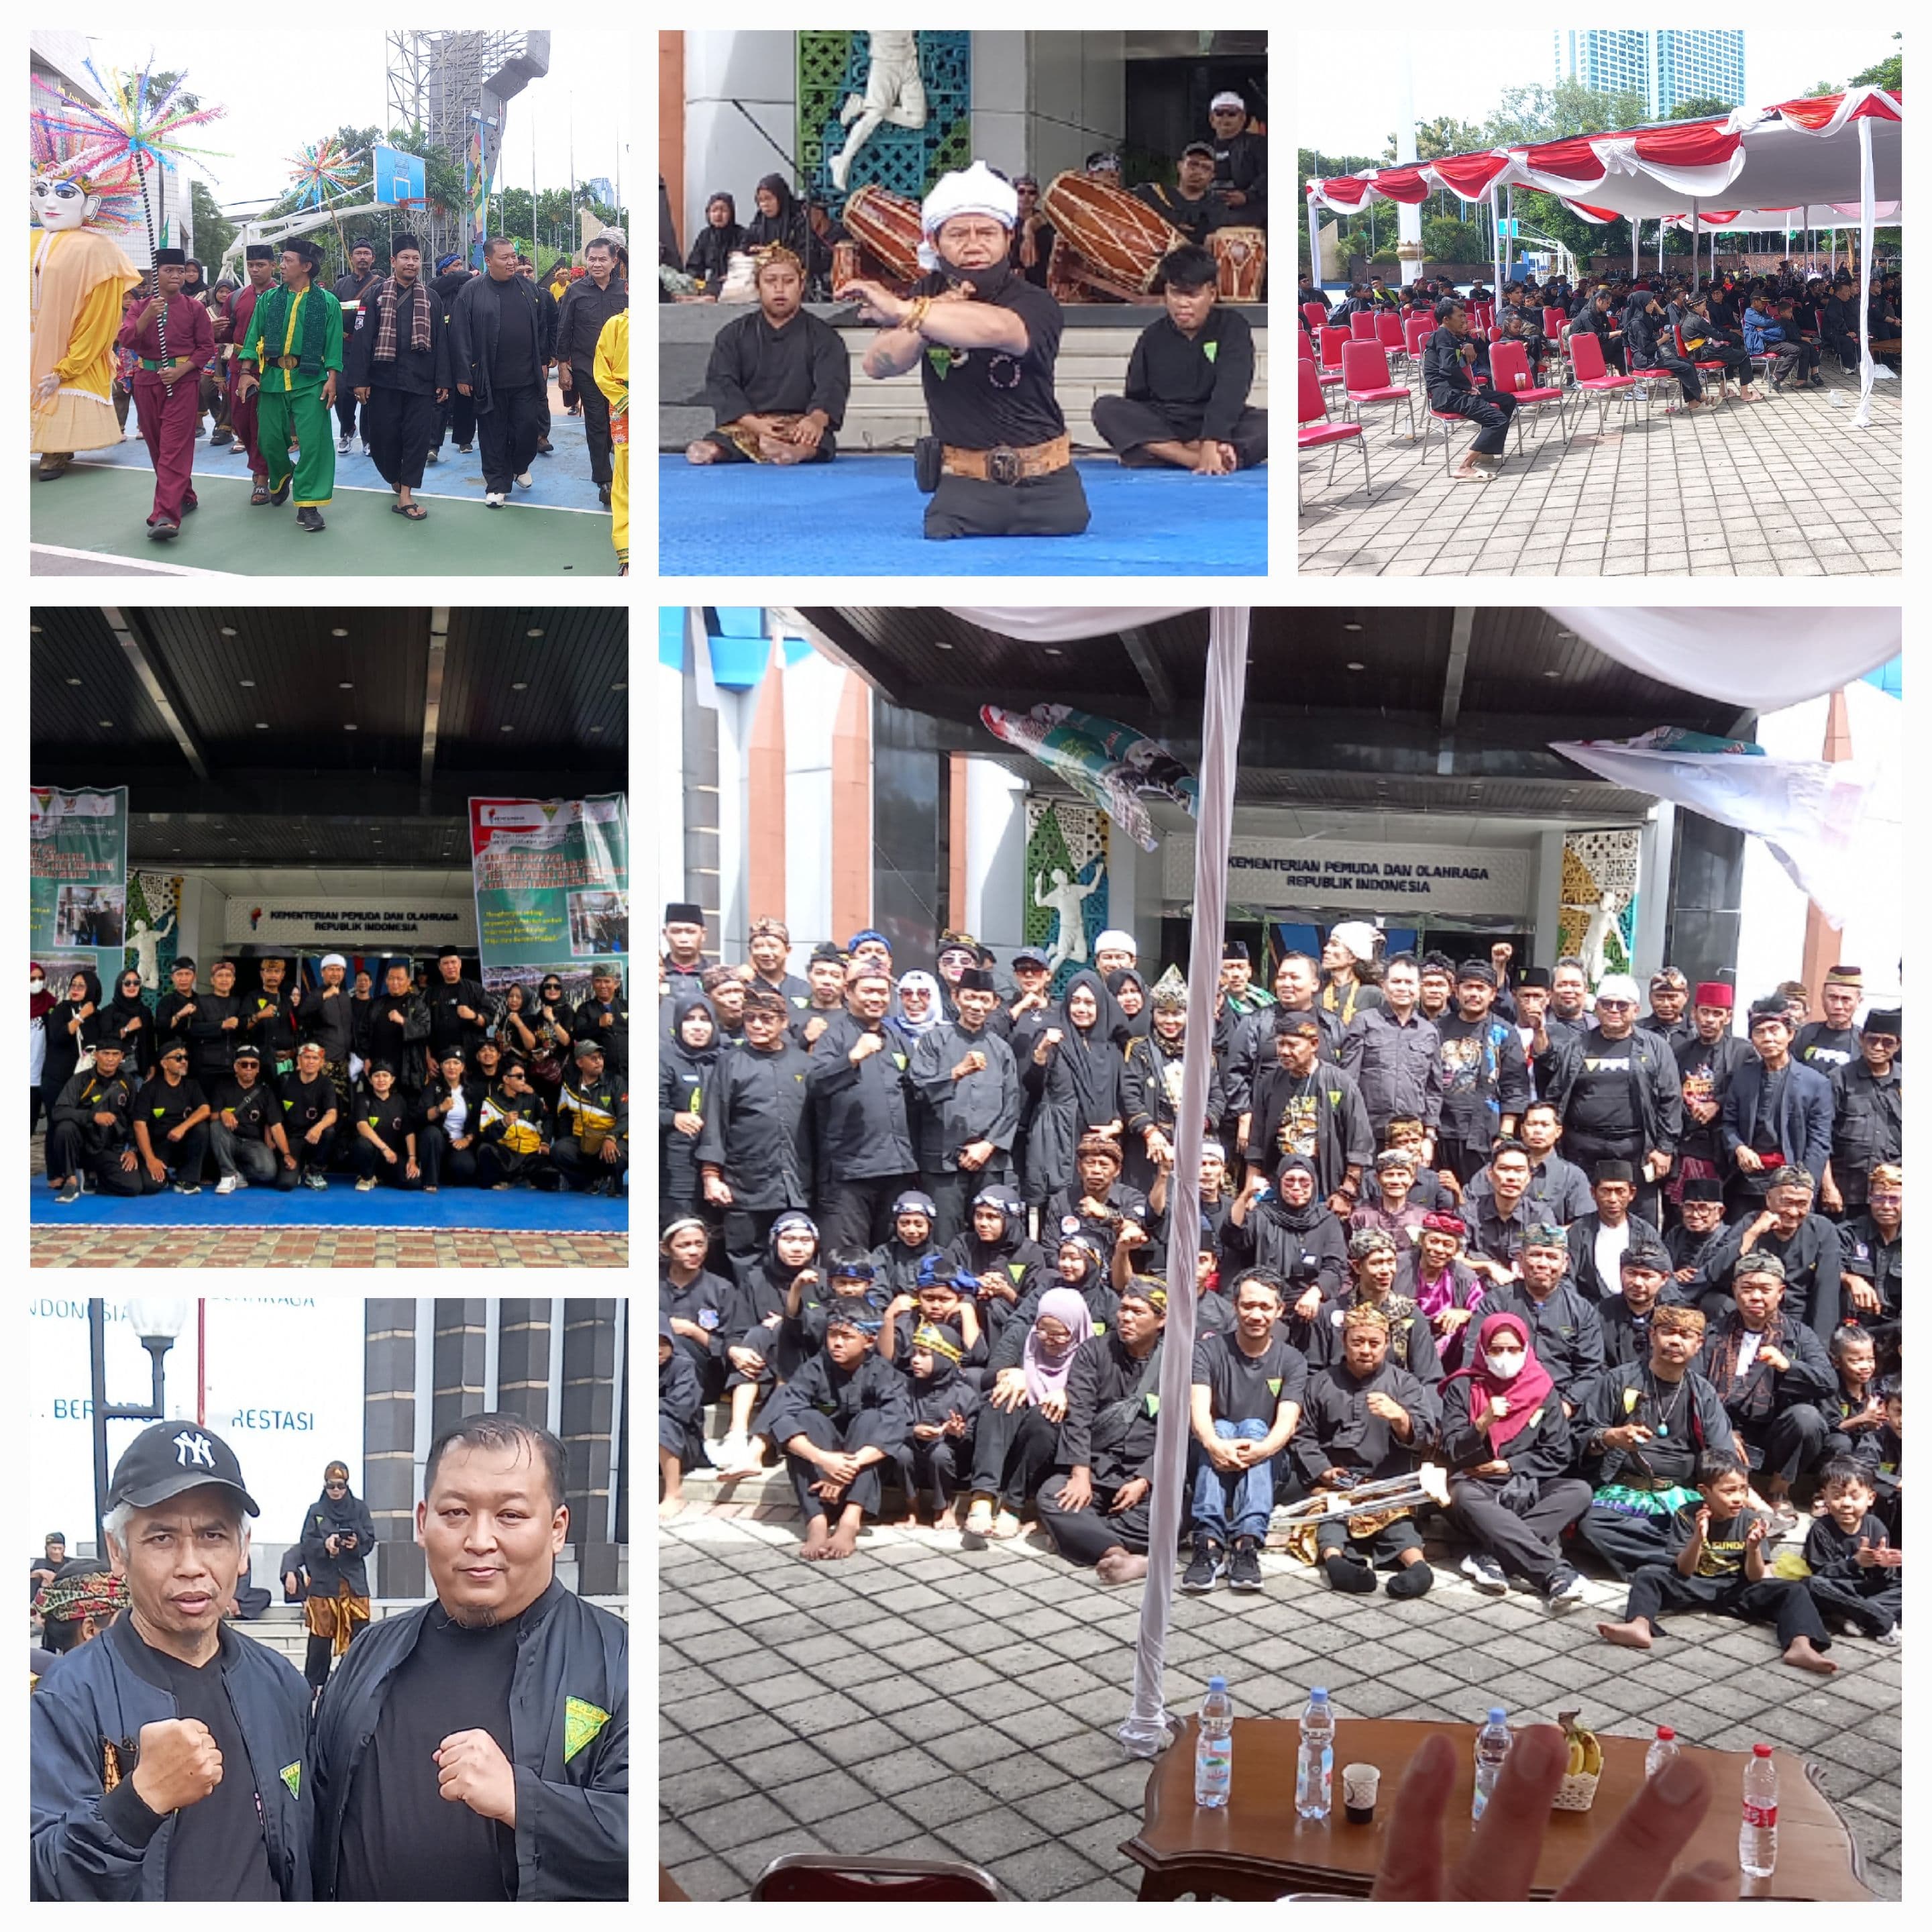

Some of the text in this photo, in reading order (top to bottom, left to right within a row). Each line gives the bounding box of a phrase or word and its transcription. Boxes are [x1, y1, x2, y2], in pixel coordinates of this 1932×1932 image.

[1228, 856, 1489, 879] KEMENTERIAN PEMUDA DAN OLAHRAGA
[1287, 875, 1430, 892] REPUBLIK INDONESIA
[270, 911, 458, 921] KEMENTERIAN PEMUDA DAN OLAHRAGA
[315, 922, 418, 931] REPUBLIK INDONESIA
[172, 1430, 217, 1468] NY
